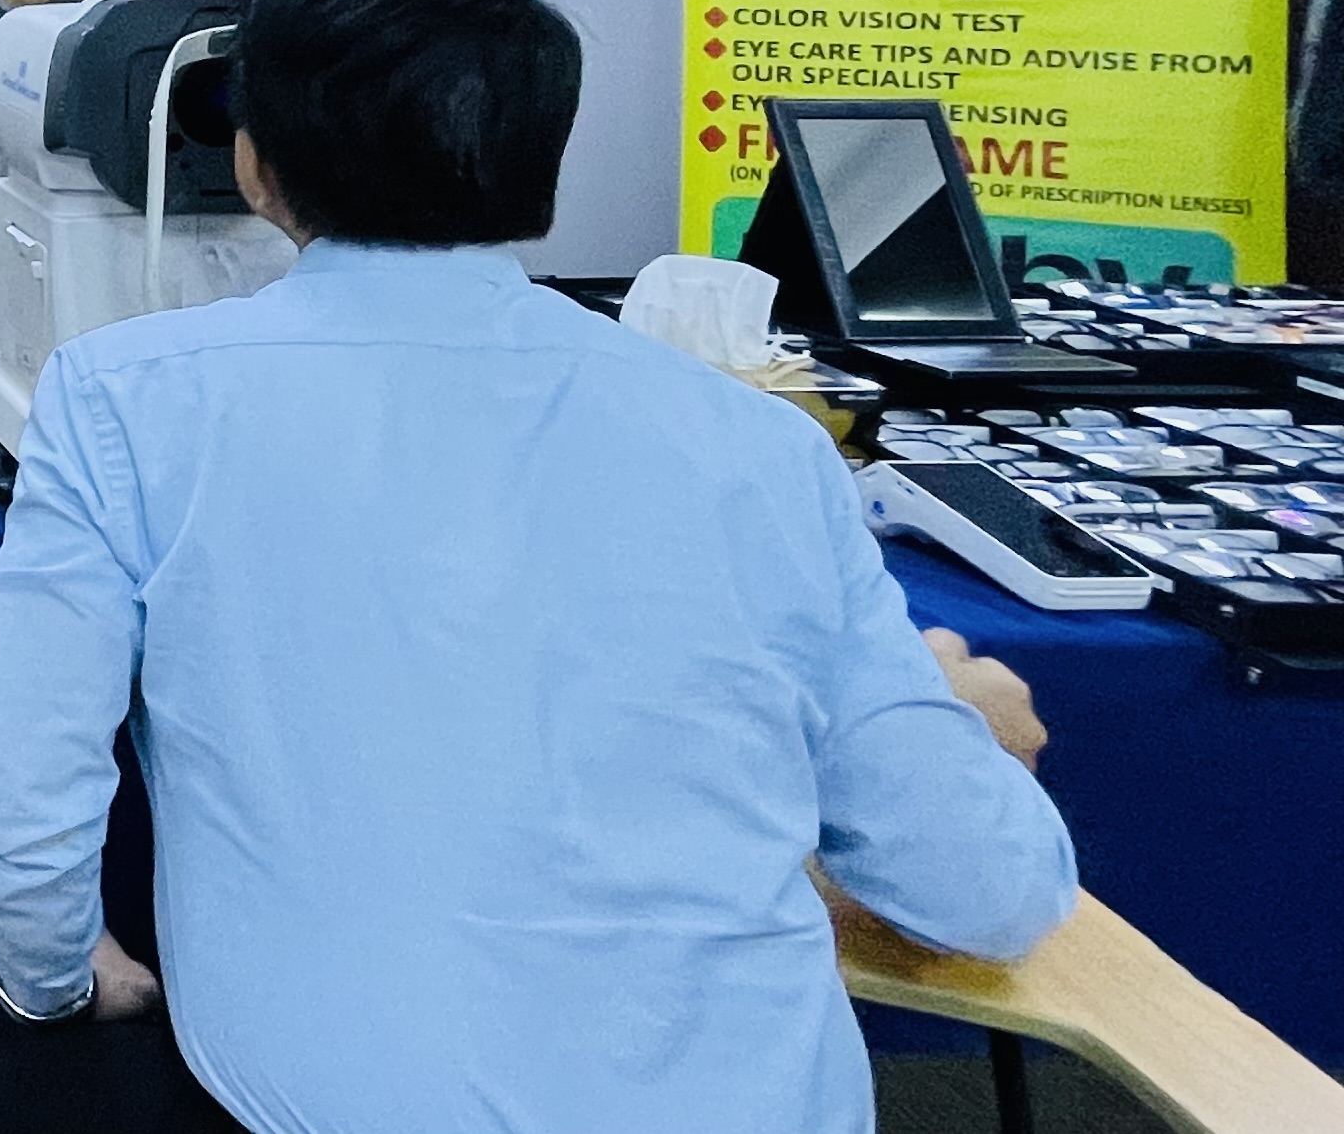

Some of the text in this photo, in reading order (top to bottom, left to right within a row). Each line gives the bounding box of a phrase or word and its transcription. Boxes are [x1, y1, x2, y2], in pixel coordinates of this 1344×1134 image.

[733, 8, 1024, 33] COLOR VISION TEST
[733, 40, 1253, 75] EYE CARE TIPS AND ADVISE FROM
[733, 64, 962, 91] OUR SPECIALIST
[989, 183, 1015, 198] OF
[1021, 184, 1163, 208] PRESCRIPTION
